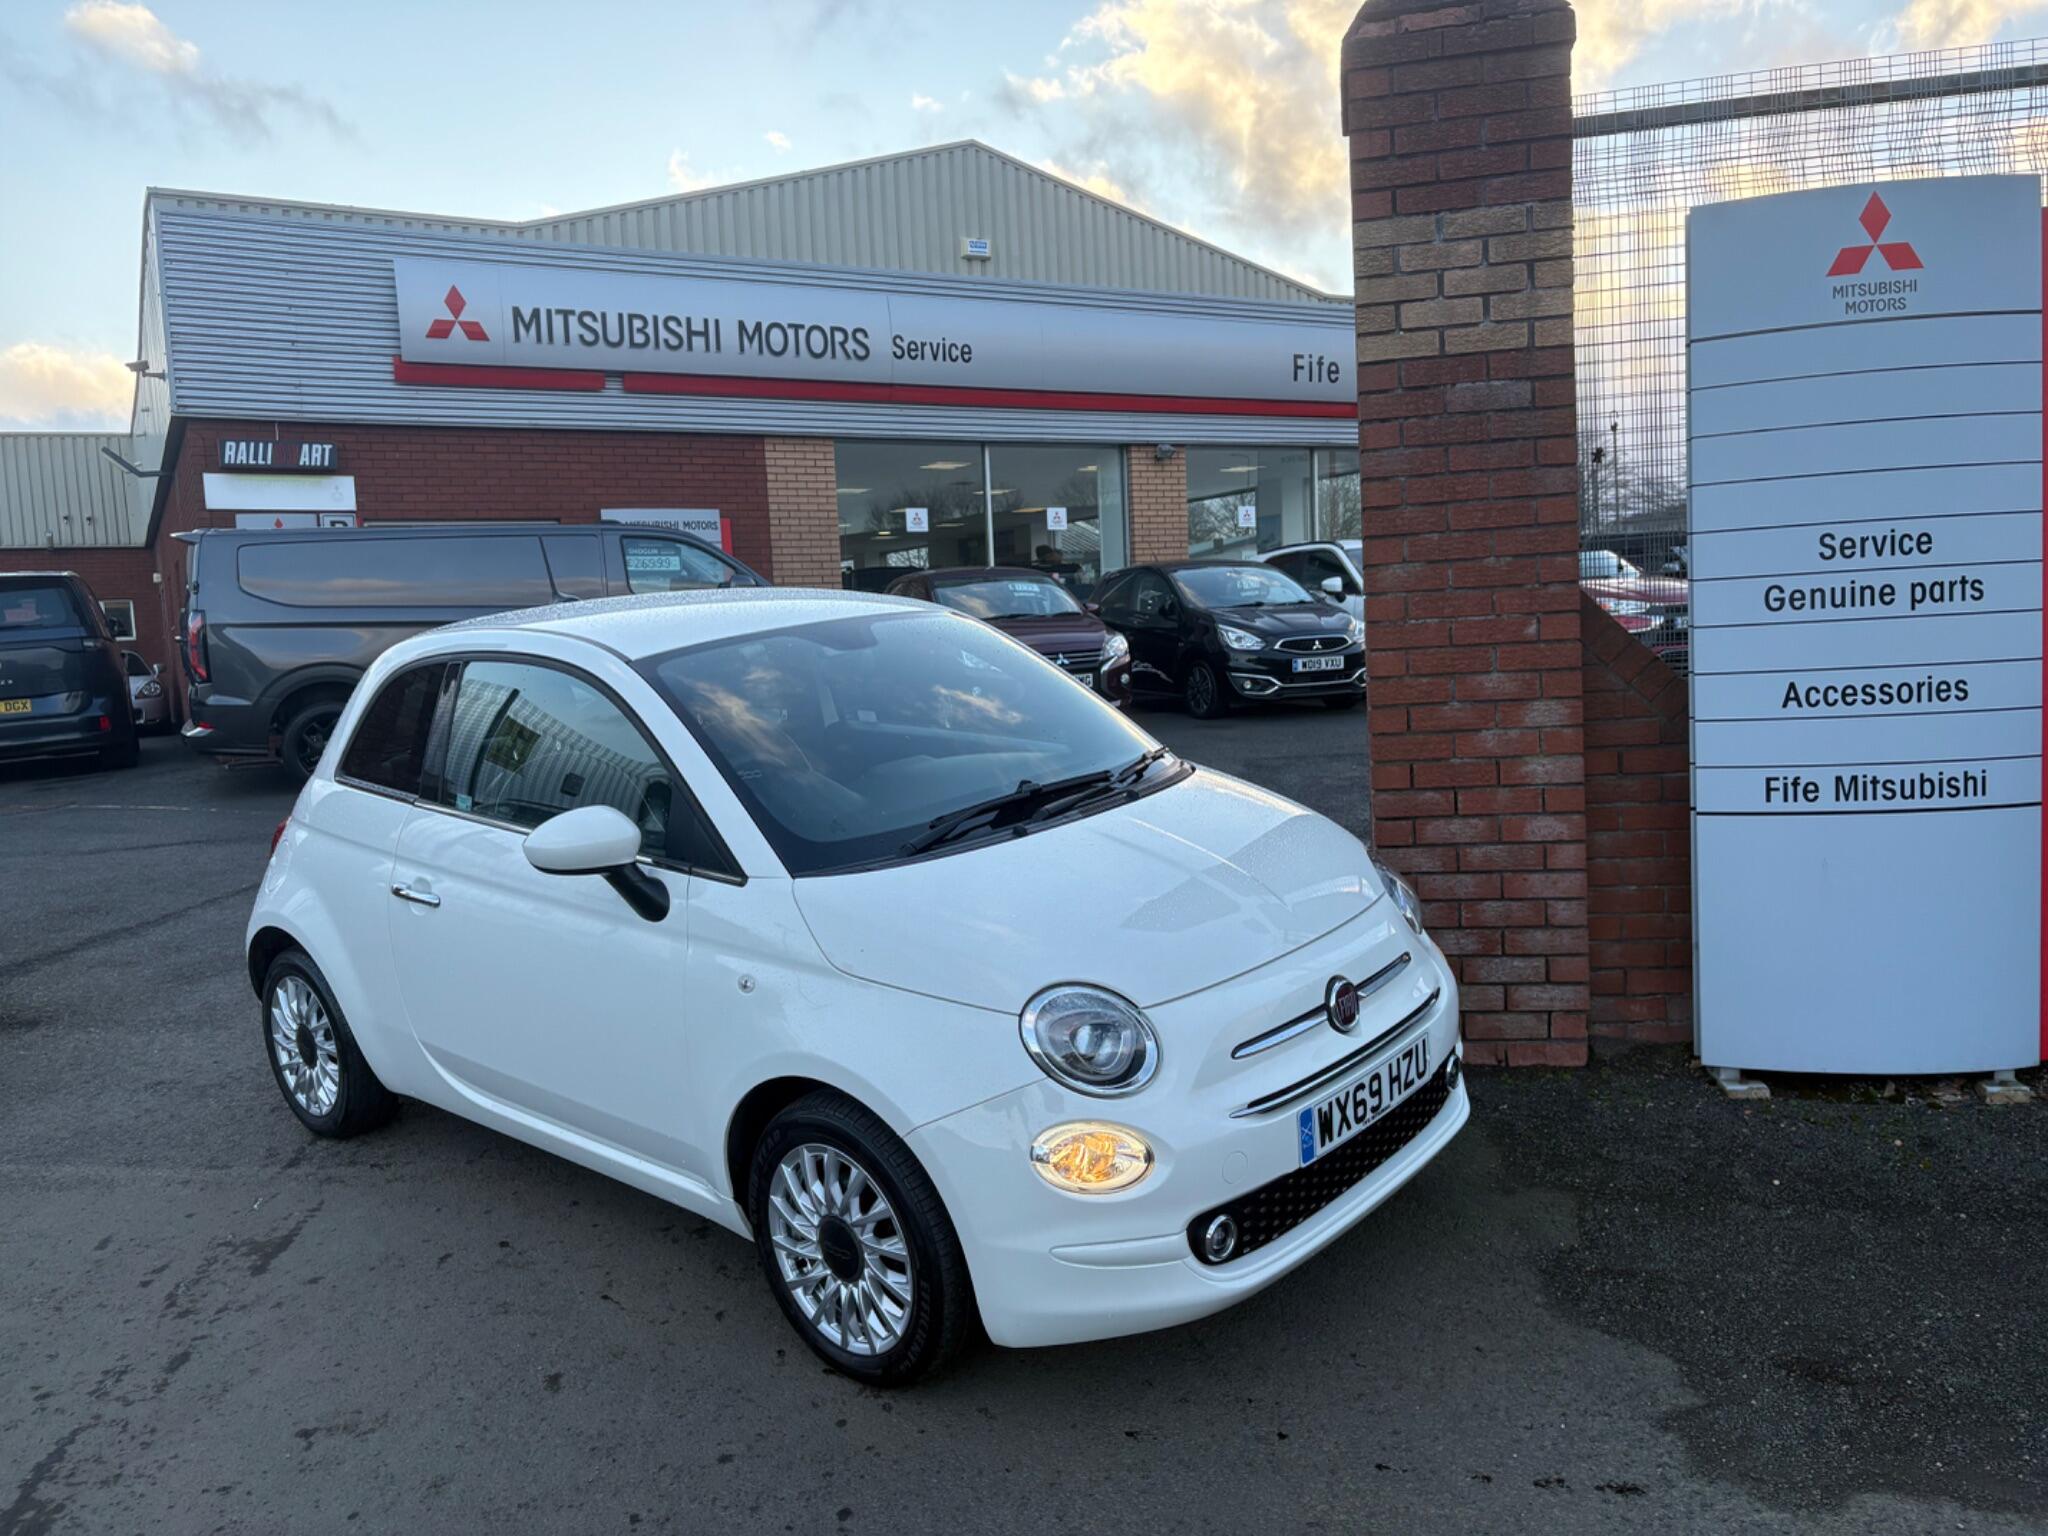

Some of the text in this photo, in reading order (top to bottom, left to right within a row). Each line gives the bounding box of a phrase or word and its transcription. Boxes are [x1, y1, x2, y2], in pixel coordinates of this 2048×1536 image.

[1832, 279, 1918, 299] MITSUBISHI
[1845, 297, 1907, 315] MOTORS
[511, 306, 870, 361] MITSUBISHI MOTORS
[892, 334, 973, 365] Service
[1293, 354, 1340, 384] Fife
[224, 441, 333, 467] RALLI ART
[683, 520, 719, 530] MOTORS
[1818, 528, 1933, 560] Service
[1764, 575, 1985, 612] Genuine parts
[1783, 675, 1969, 709] Accessories
[1764, 768, 1987, 804] Fife Mitsubishi
[1317, 1038, 1428, 1148] WX69 HZU
